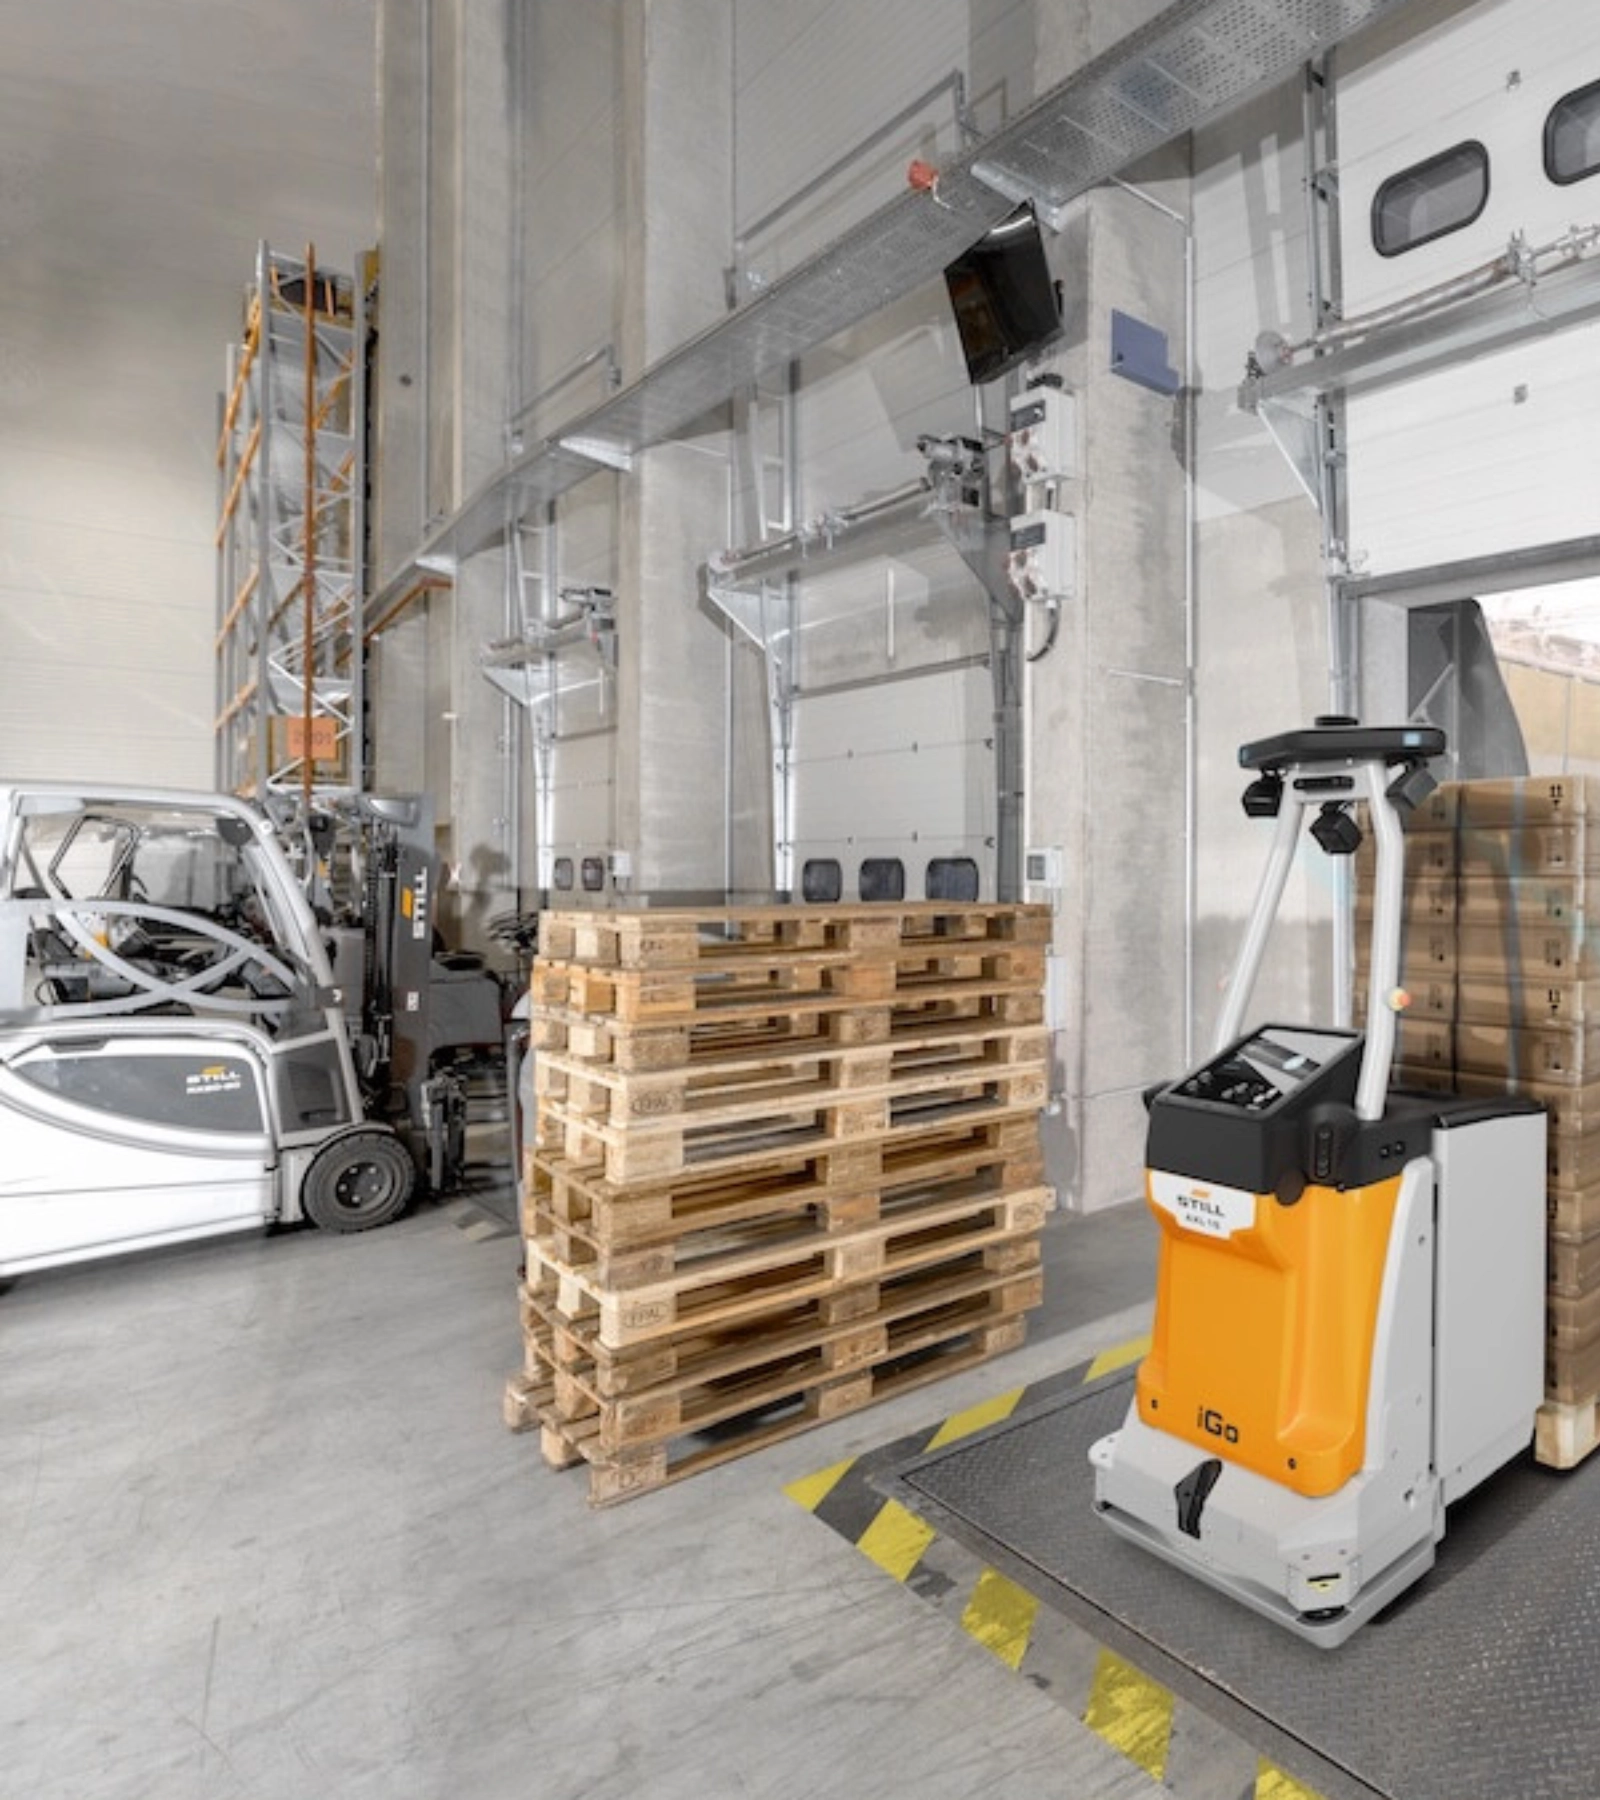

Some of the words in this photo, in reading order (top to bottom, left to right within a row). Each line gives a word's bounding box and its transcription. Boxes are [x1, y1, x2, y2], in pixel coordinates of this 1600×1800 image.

[412, 866, 428, 939] STILL
[186, 1071, 241, 1084] STILL
[1177, 1195, 1226, 1218] STILL
[1197, 1404, 1239, 1444] iGo
